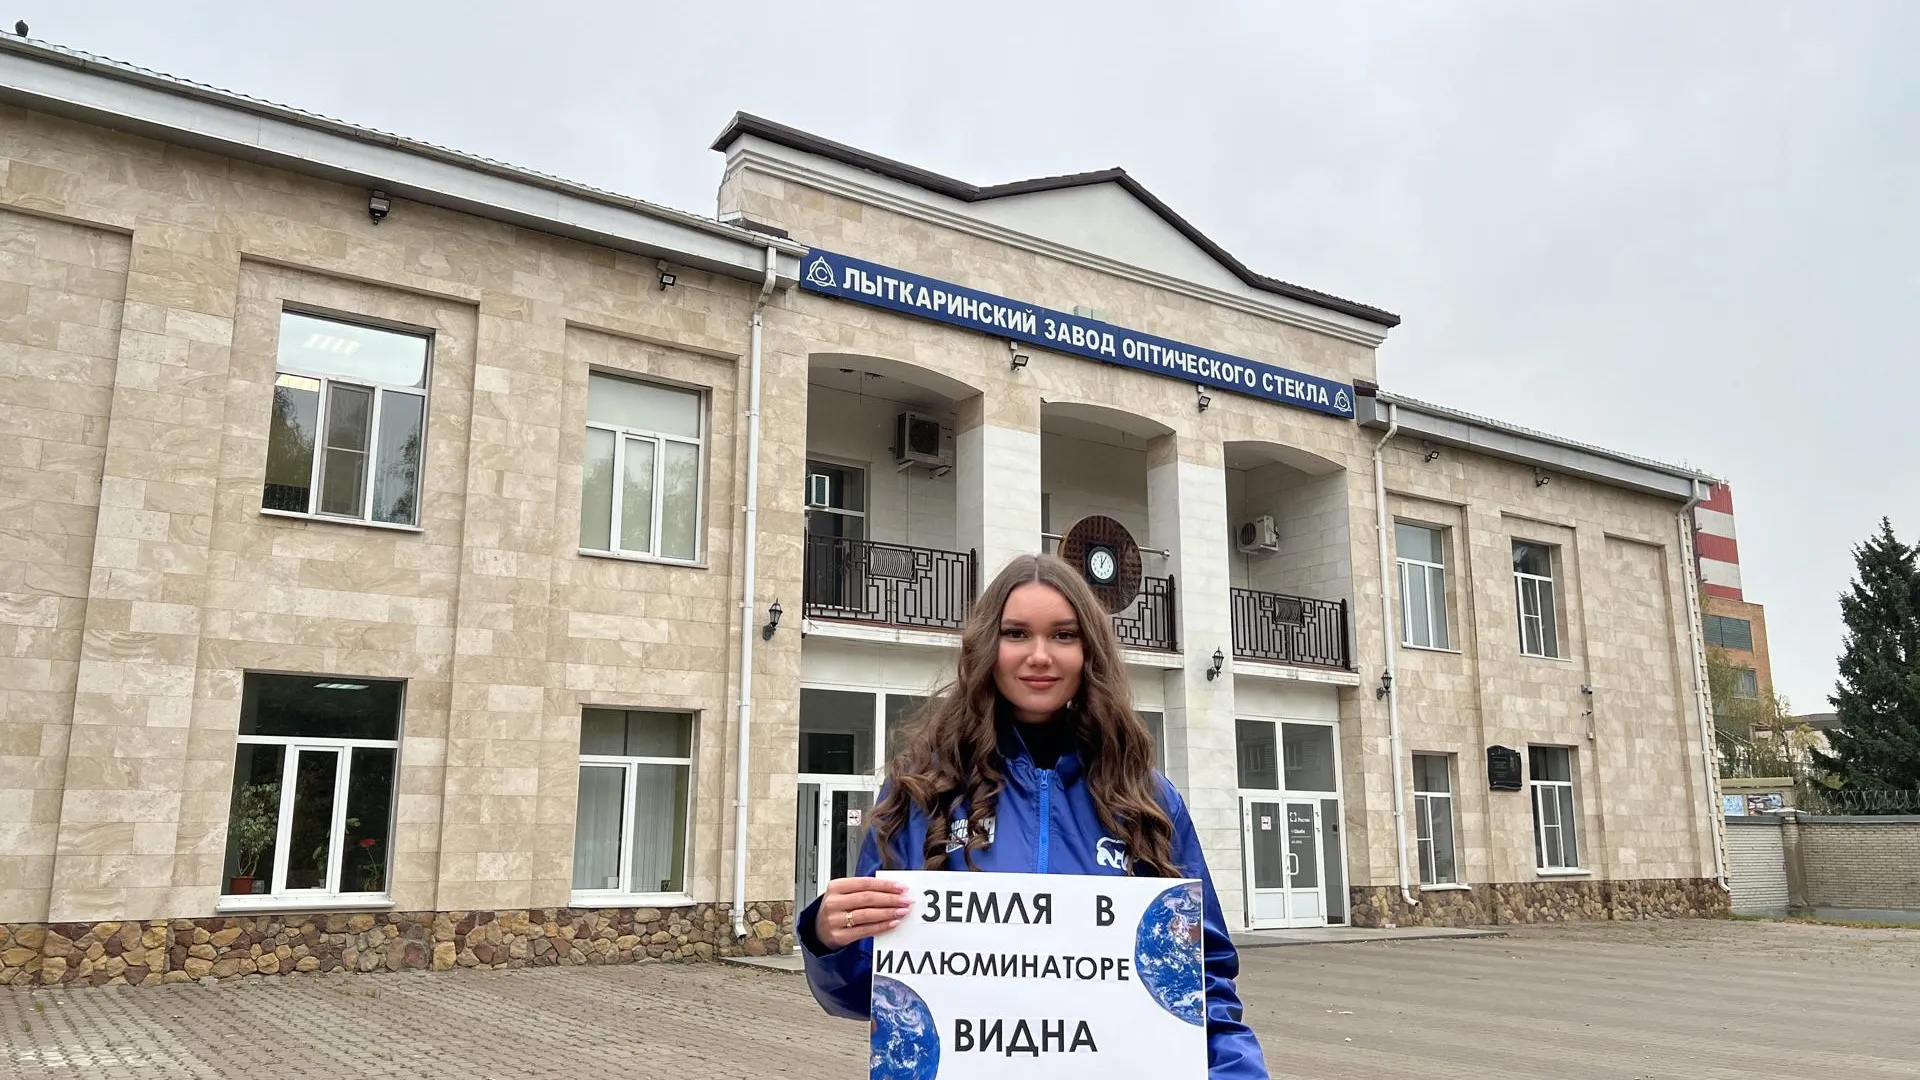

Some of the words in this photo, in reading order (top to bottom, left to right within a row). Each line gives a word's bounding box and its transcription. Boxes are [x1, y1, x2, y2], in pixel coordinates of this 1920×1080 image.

[842, 266, 1036, 335] ЛЫТКАРИНСКИЙ
[1044, 318, 1116, 357] ЗАВОД
[1122, 338, 1256, 388] ОПТИЧЕСКОГО
[1262, 372, 1330, 406] СТЕКЛА
[921, 889, 1052, 925] ЗЕМЛЯ
[1096, 895, 1115, 927] В
[876, 949, 1130, 981] ИЛЛЮМИНАТОРЕ
[954, 1018, 1098, 1058] ВИДНА
